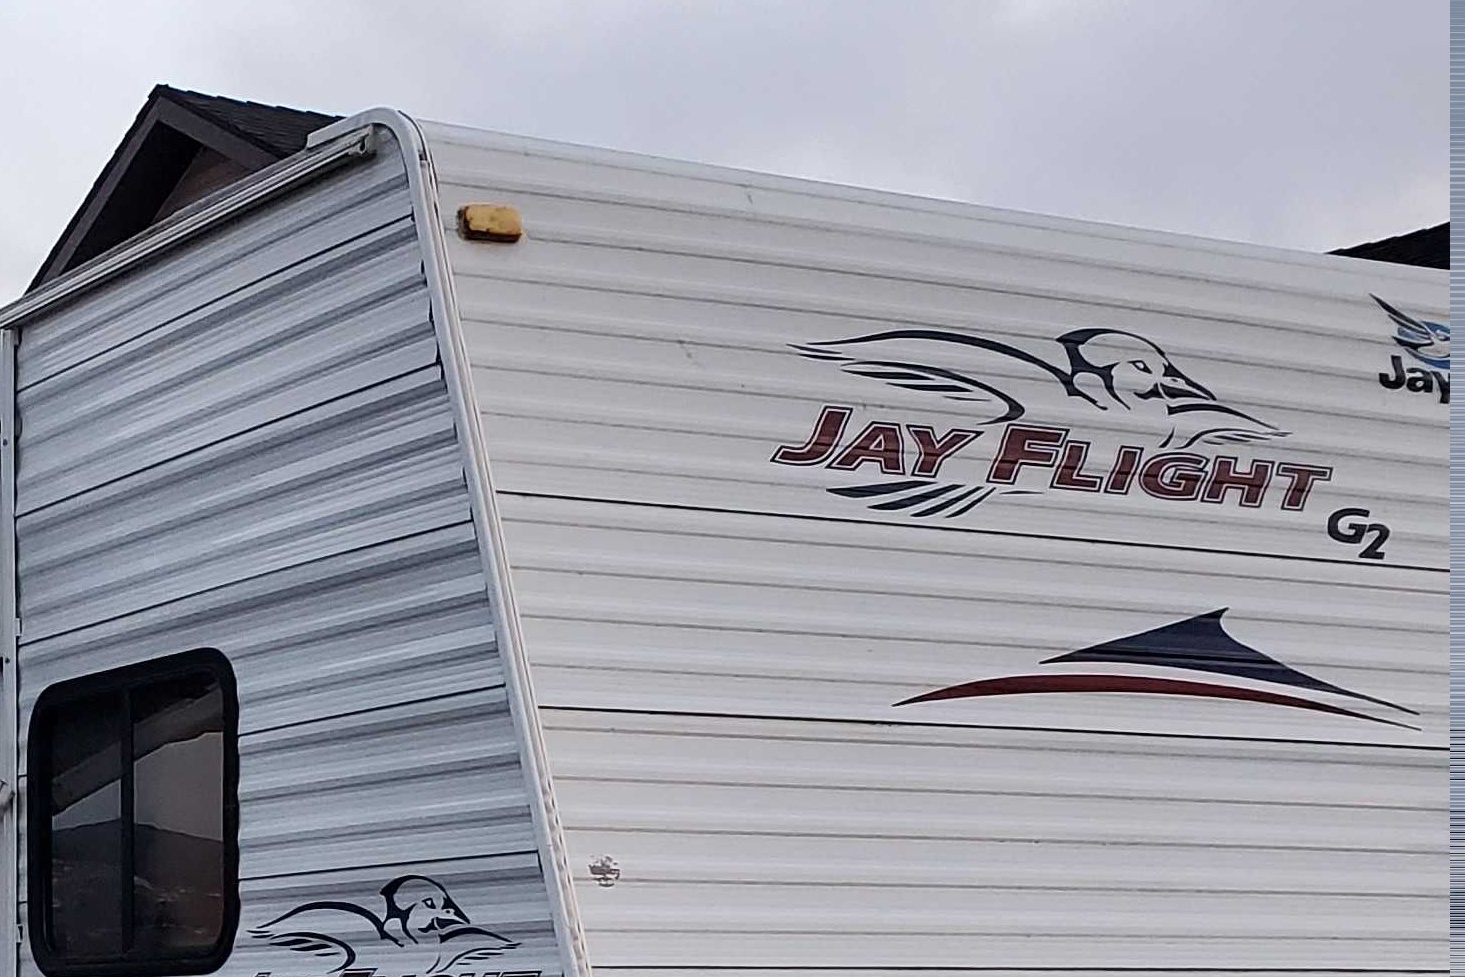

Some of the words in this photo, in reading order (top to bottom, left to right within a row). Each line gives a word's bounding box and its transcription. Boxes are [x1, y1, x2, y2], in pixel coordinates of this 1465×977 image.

[1379, 354, 1450, 404] Jay
[770, 405, 984, 478] JAY
[986, 423, 1333, 511] FLIGHT
[1327, 508, 1390, 560] G2
